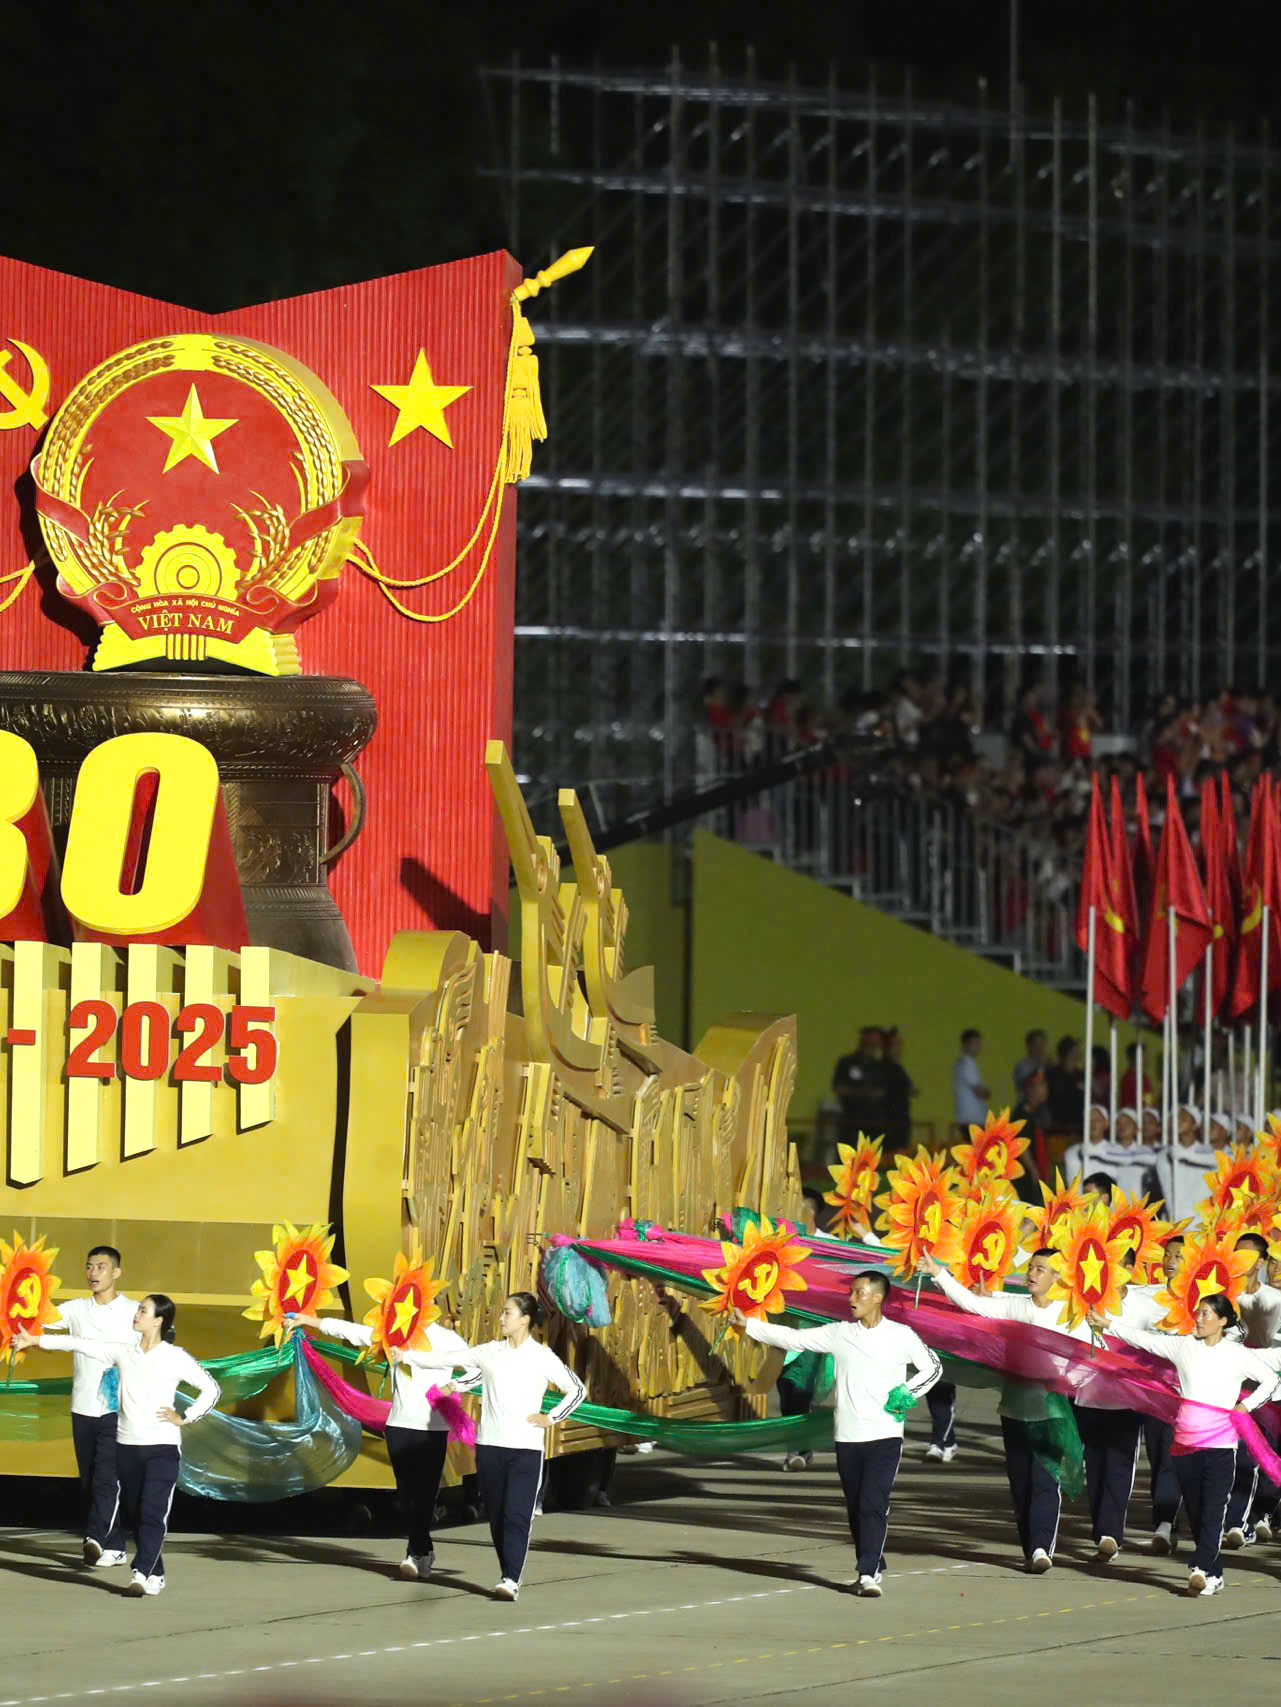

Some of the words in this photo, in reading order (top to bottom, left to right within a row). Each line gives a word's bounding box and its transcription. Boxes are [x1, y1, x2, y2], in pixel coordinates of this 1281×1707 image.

[137, 609, 183, 631] VIỆT
[187, 613, 235, 634] NAM
[7, 1028, 36, 1047] -
[66, 1000, 278, 1085] 2025
